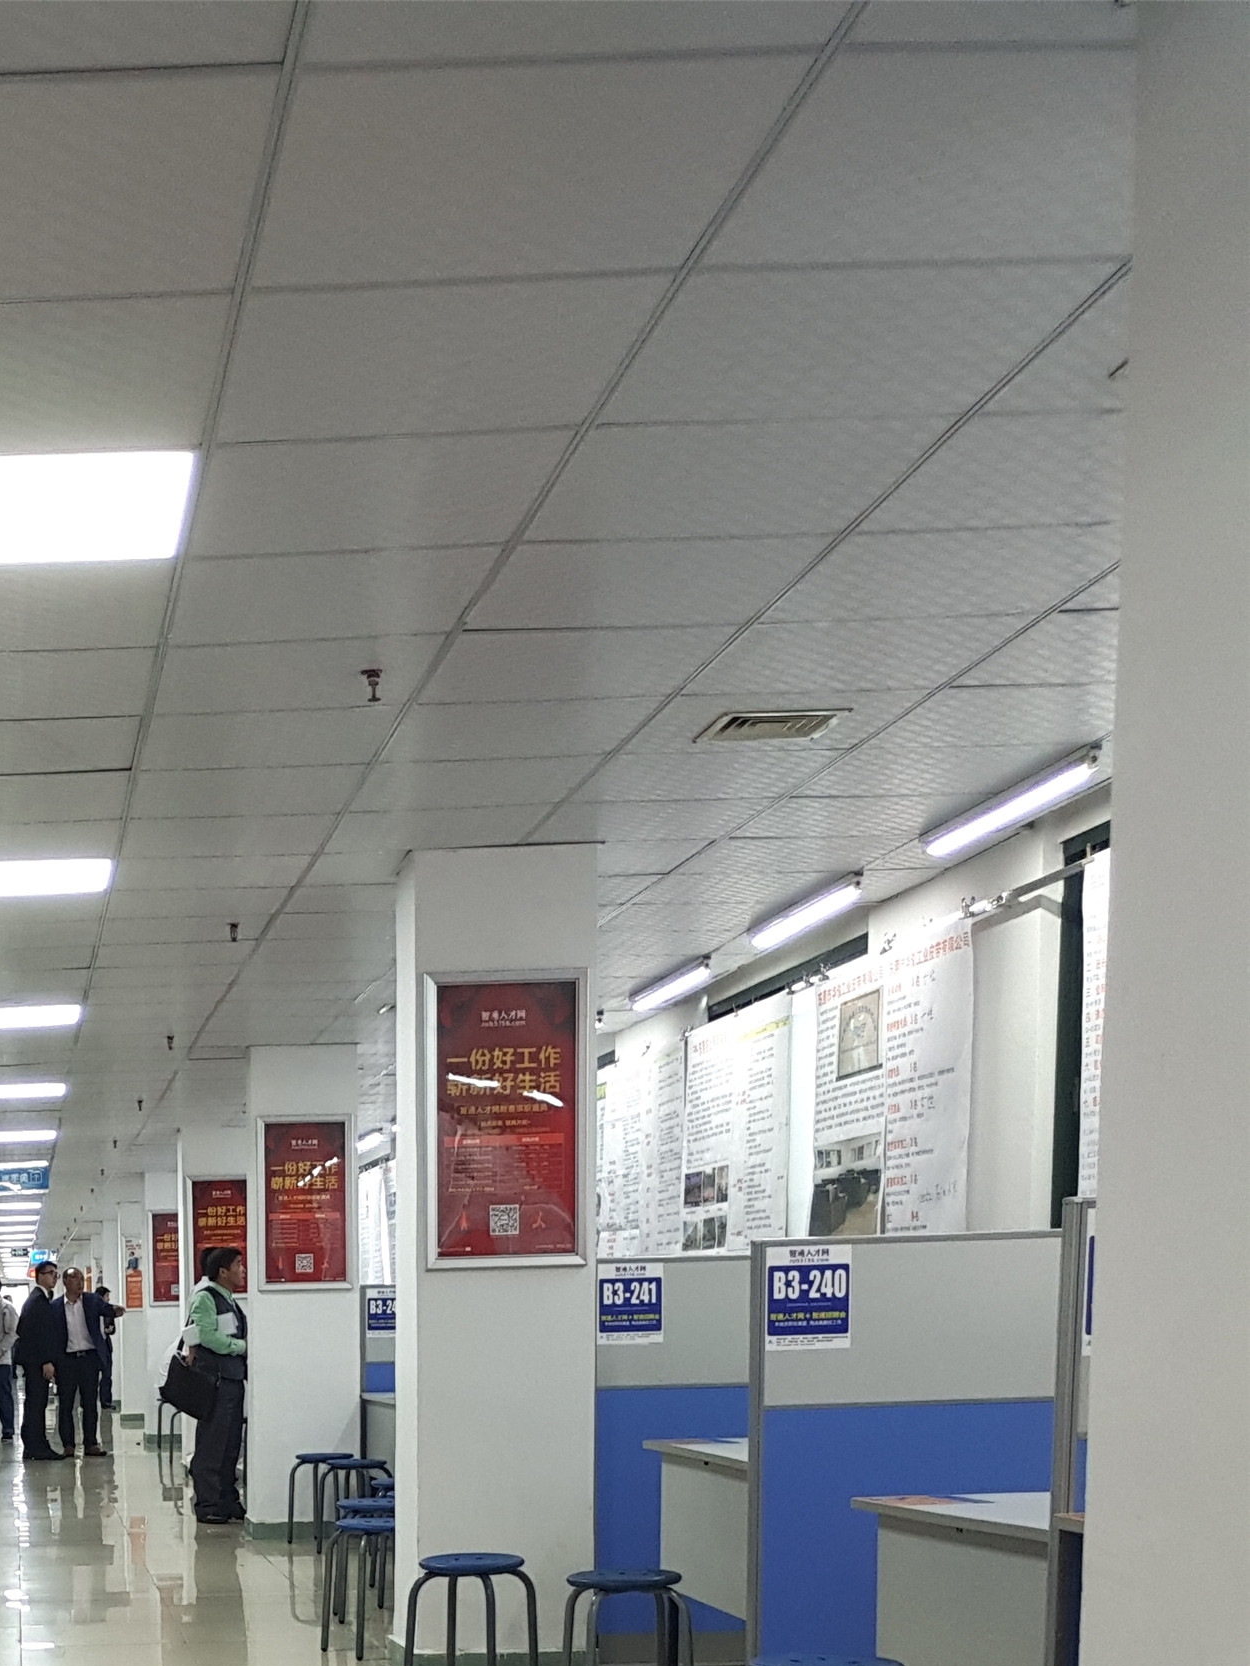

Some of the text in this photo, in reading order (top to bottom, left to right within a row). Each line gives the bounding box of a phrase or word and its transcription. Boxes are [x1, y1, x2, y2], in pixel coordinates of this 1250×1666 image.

[446, 1045, 561, 1070] 一份好工作
[603, 1281, 656, 1305] B3-241
[773, 1269, 846, 1300] B3-240
